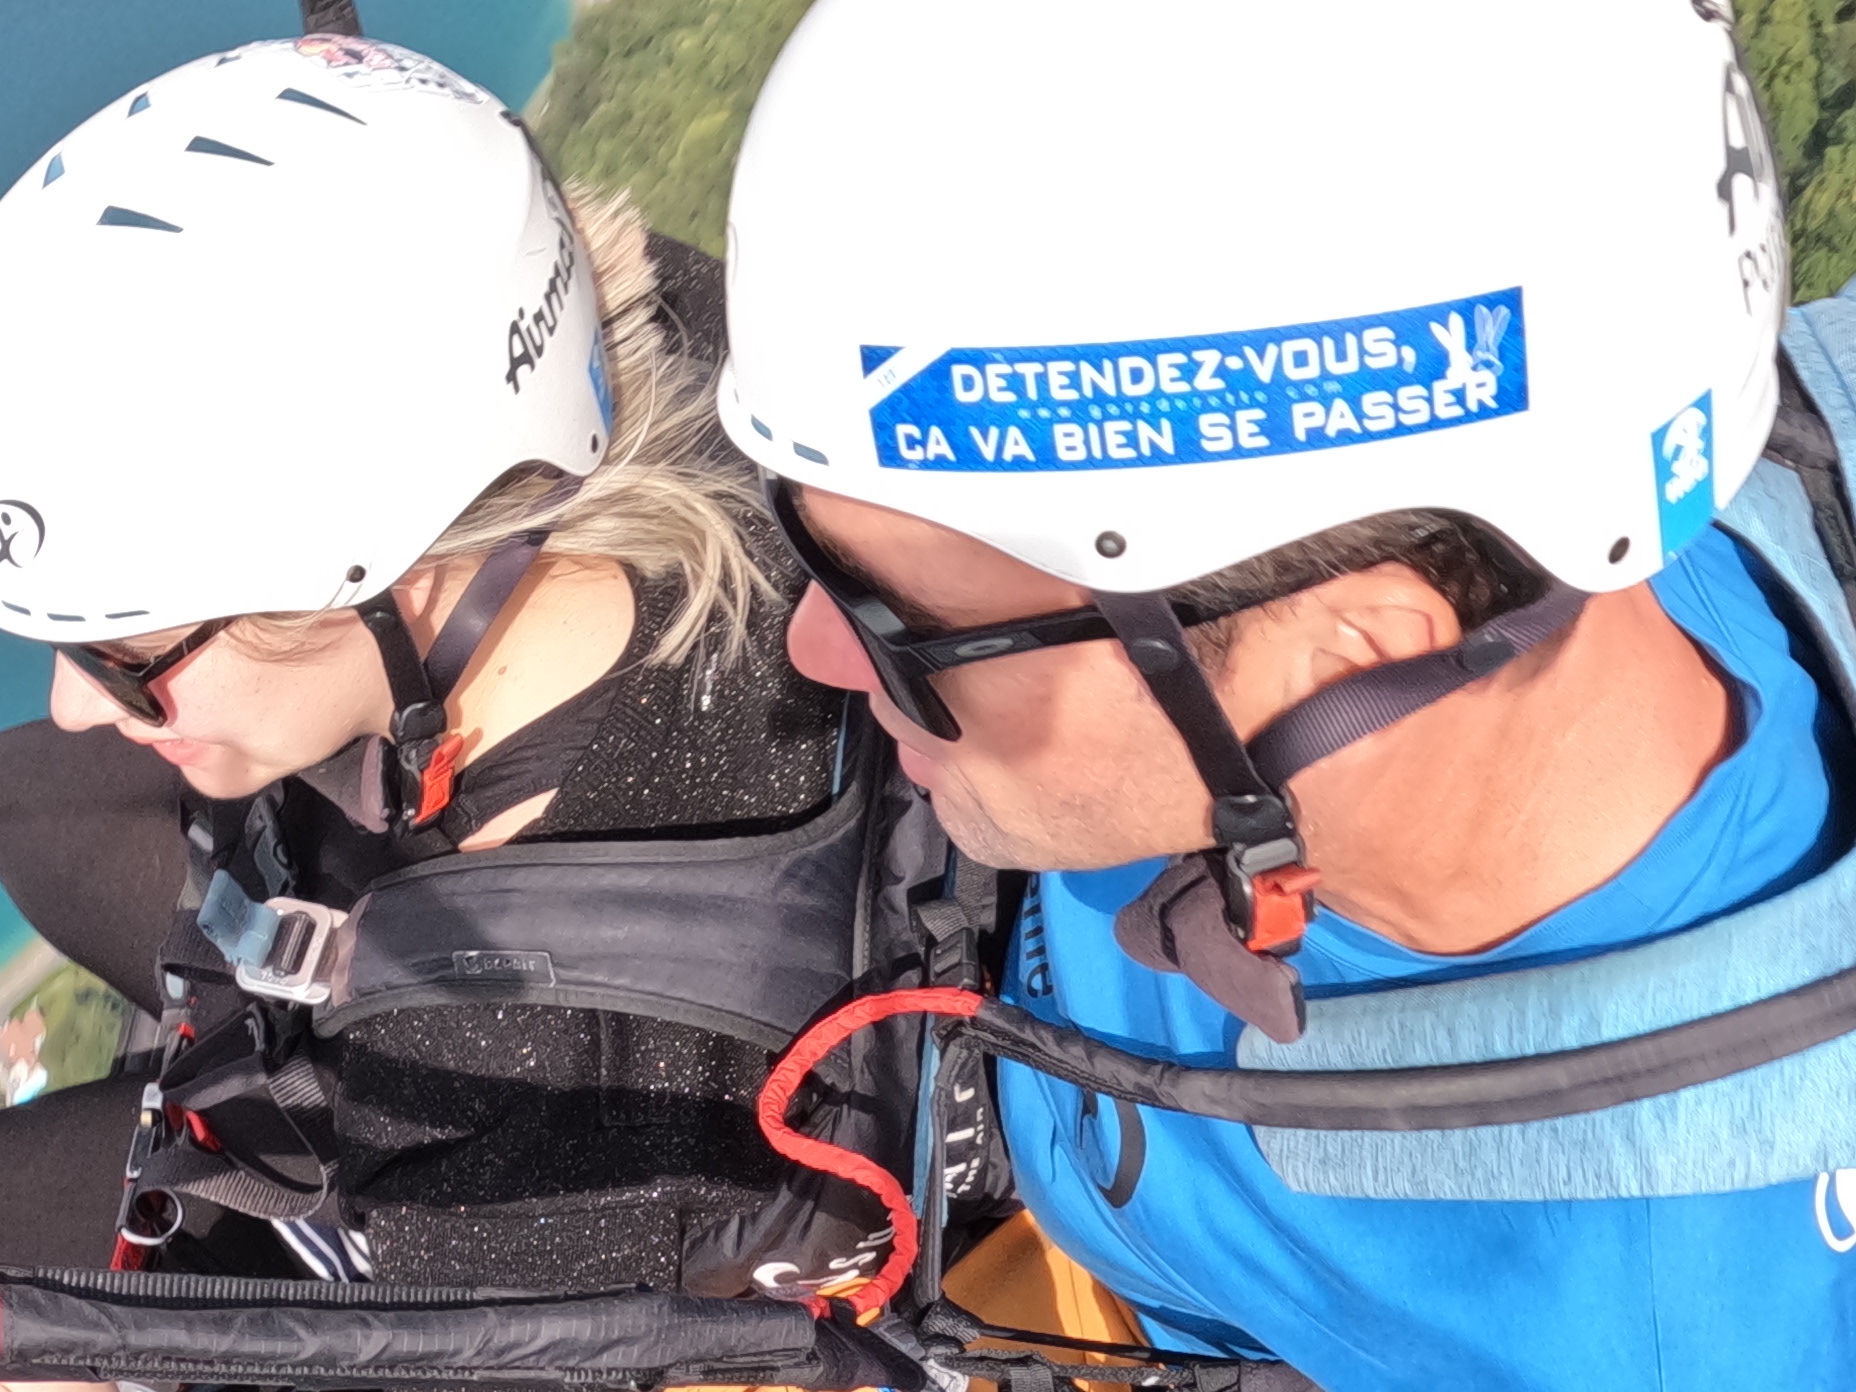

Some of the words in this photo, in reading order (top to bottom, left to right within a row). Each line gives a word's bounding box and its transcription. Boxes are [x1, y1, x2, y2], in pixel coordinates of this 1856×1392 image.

[968, 423, 1037, 463] VA
[1052, 417, 1176, 463] BIEN
[1198, 407, 1271, 453] SE
[1291, 370, 1499, 443] PASSER
